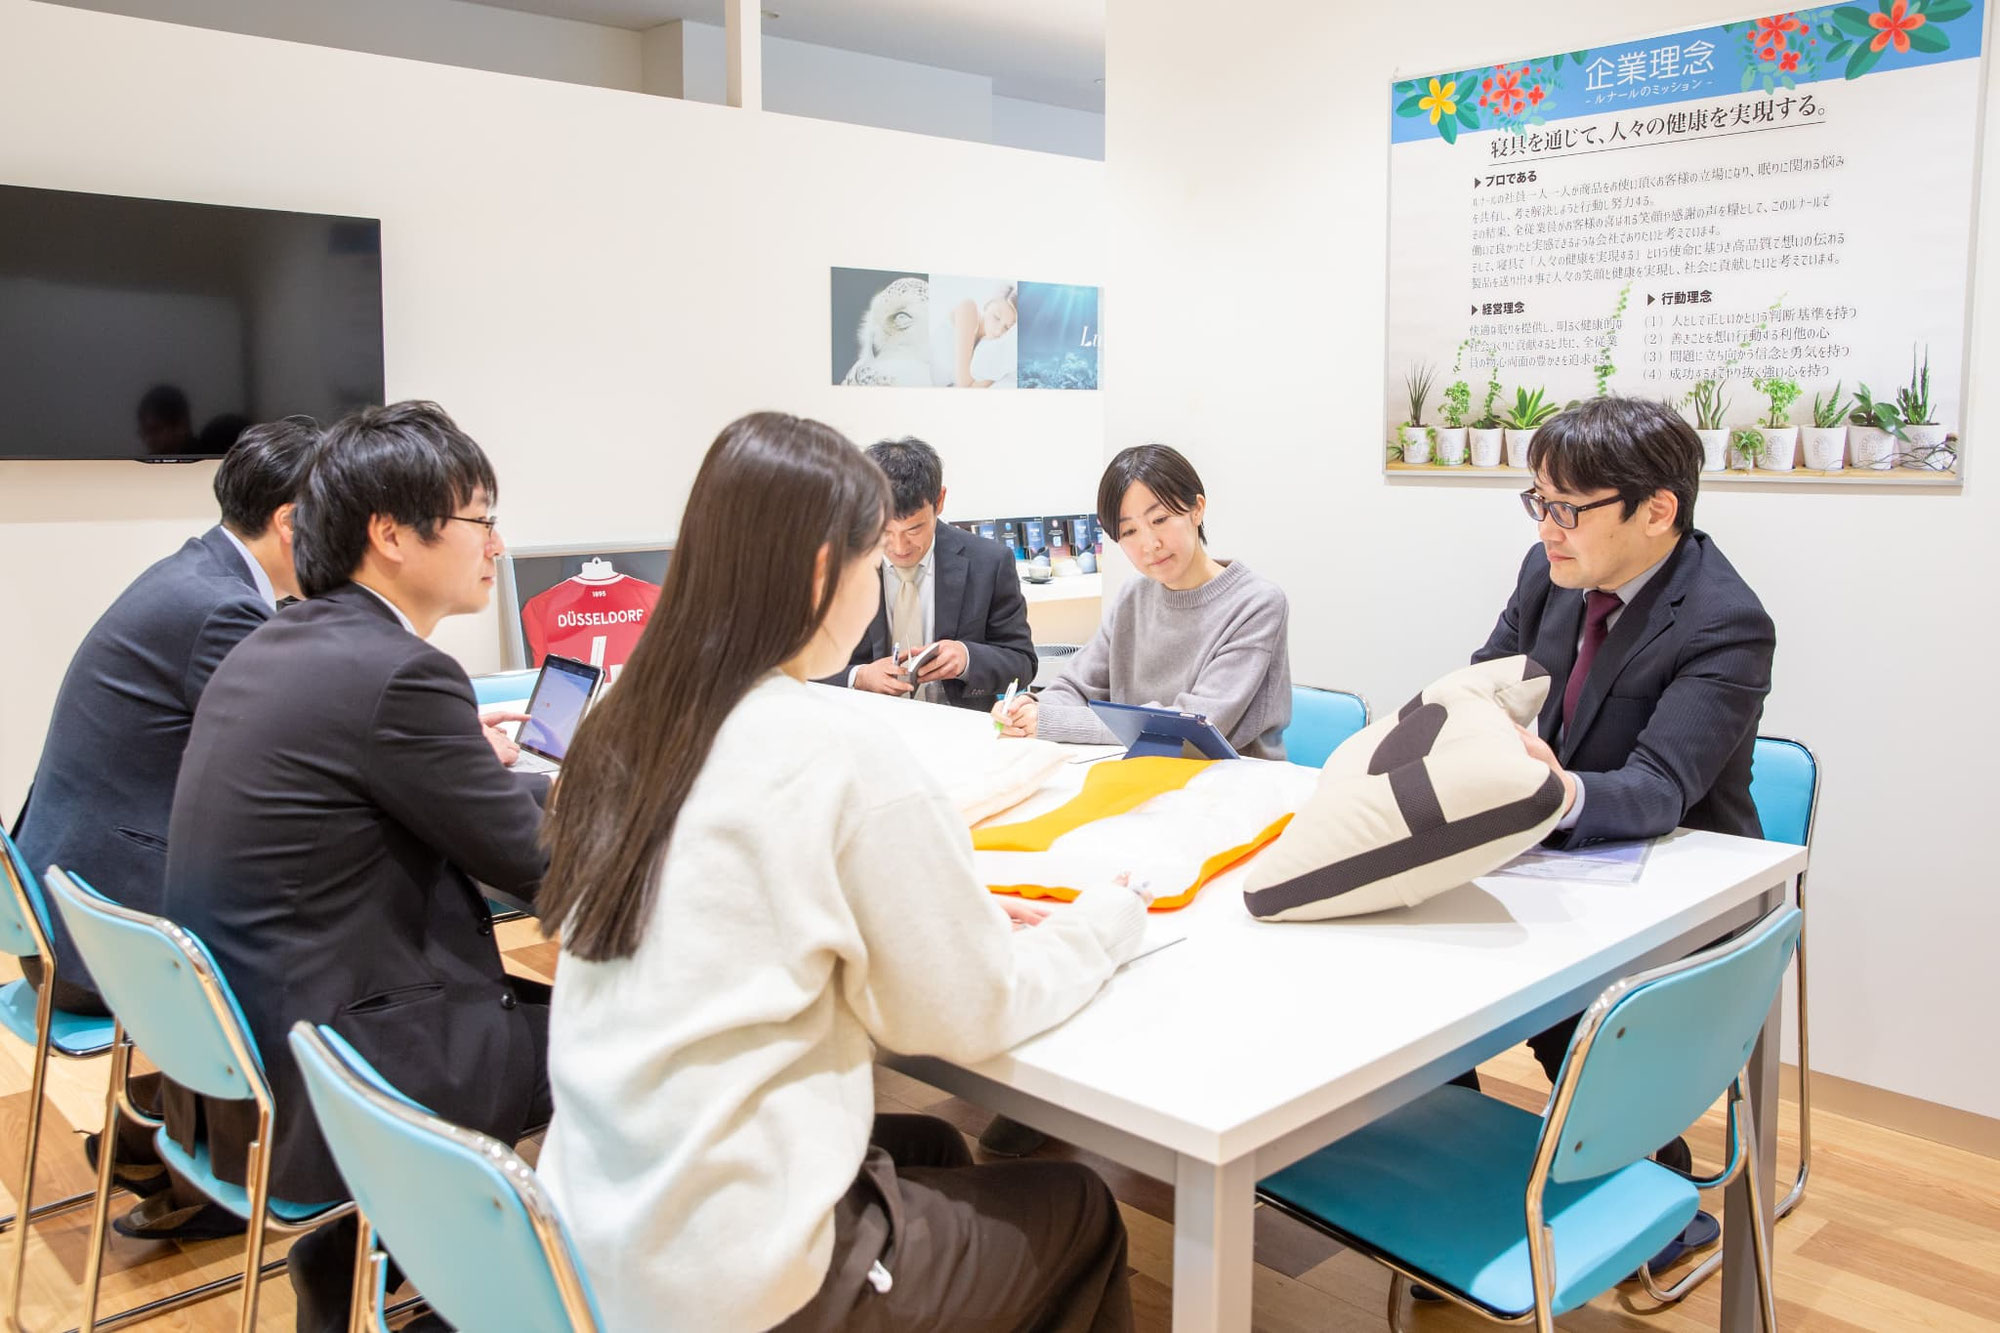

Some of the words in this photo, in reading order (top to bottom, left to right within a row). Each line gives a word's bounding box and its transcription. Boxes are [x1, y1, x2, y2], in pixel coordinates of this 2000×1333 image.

[1585, 39, 1716, 91] 企業理念
[1491, 95, 1826, 159] 寝具を通じて、人々の健康を実現する。
[1485, 170, 1538, 188] プロである
[1661, 289, 1713, 305] 行動理念
[1482, 301, 1525, 315] 経営理念
[557, 608, 645, 628] DÜSSELDORF
